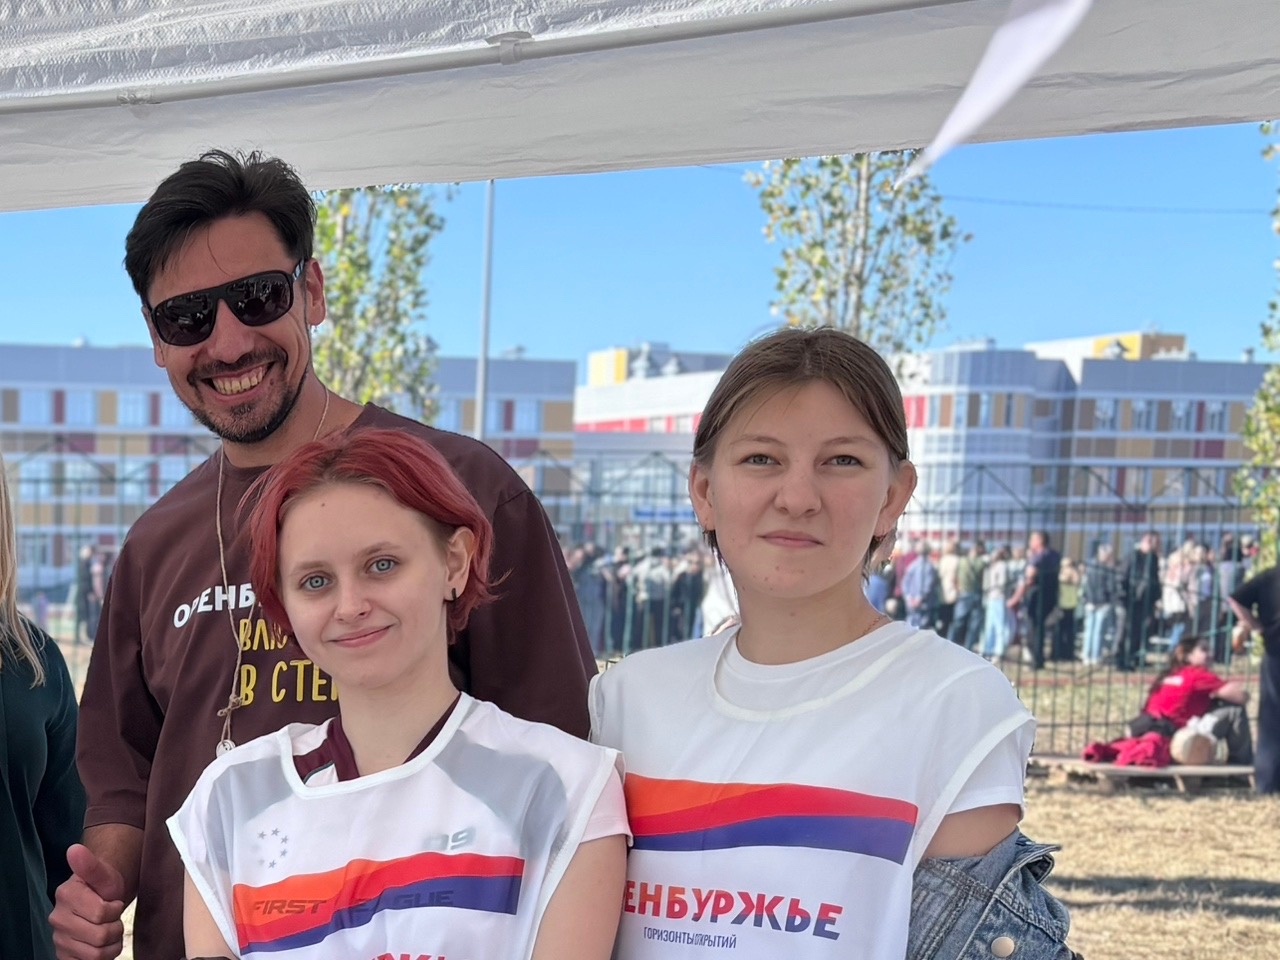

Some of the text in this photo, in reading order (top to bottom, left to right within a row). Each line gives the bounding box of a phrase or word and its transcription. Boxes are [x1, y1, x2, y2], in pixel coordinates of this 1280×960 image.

[174, 583, 256, 628] ОРЕНБ
[240, 664, 257, 706] В
[624, 880, 843, 940] ЕНБУРЖЬЕ
[643, 926, 695, 945] ГОРИЗОНТЫ
